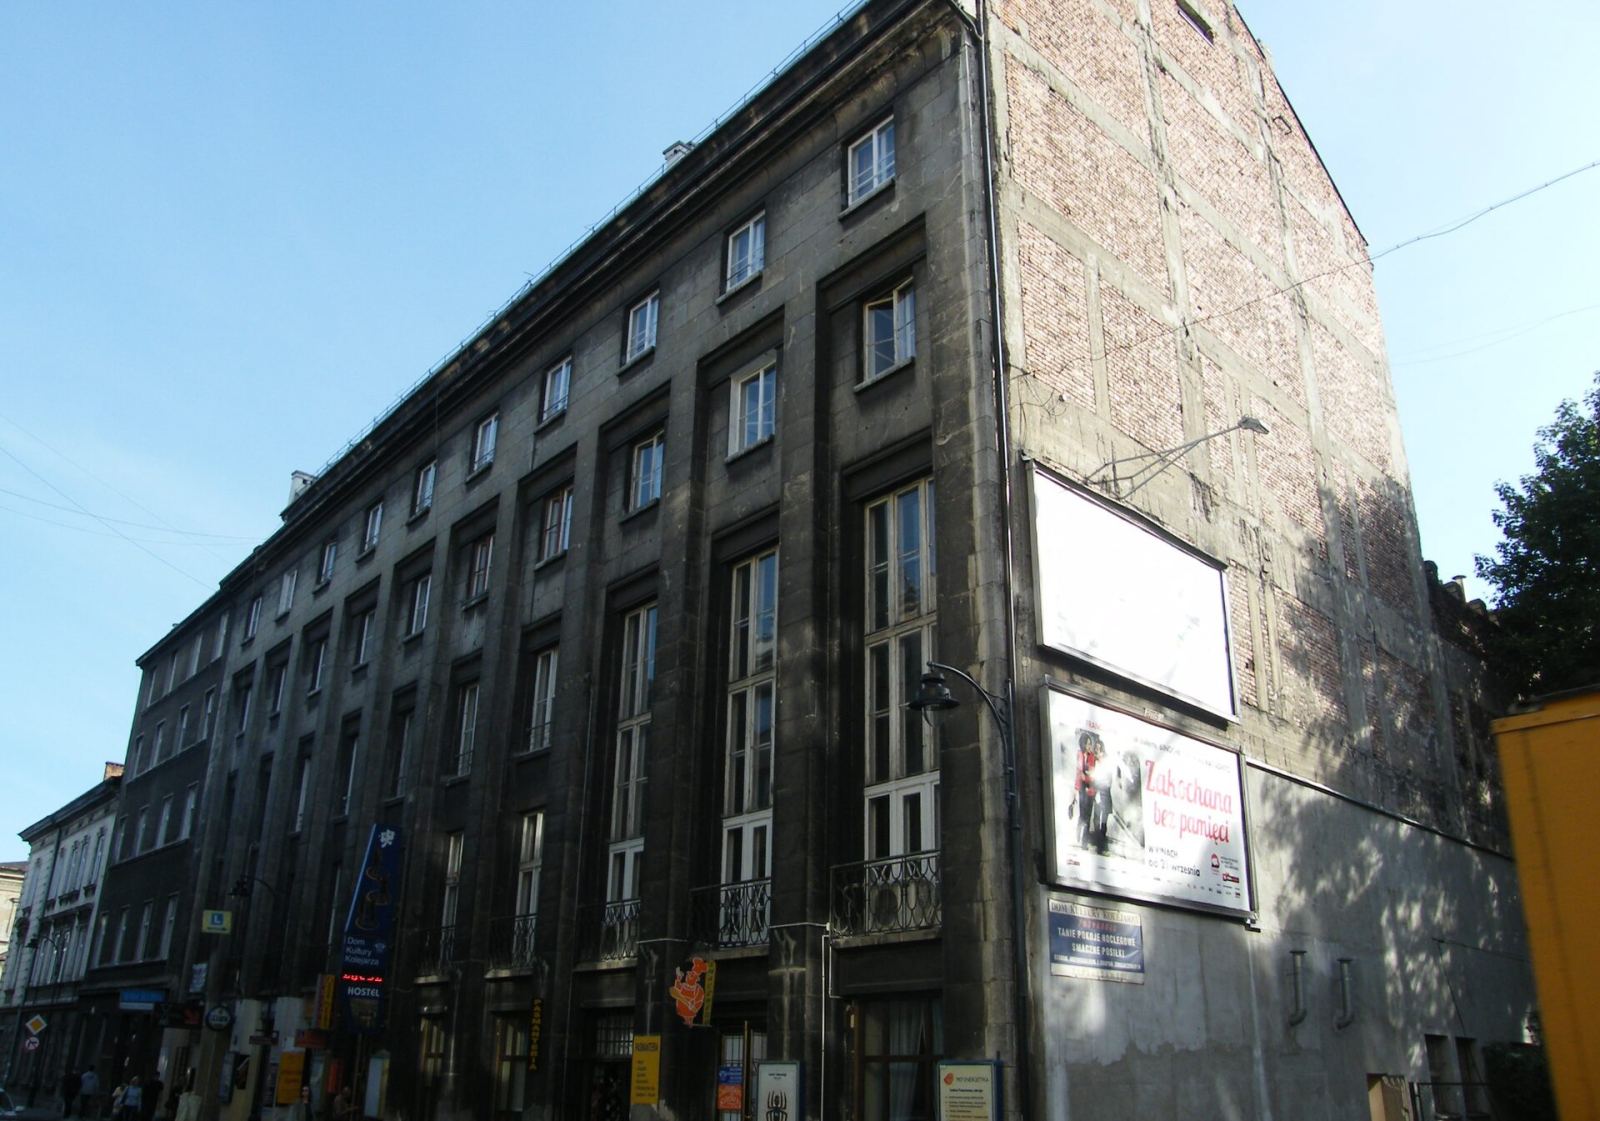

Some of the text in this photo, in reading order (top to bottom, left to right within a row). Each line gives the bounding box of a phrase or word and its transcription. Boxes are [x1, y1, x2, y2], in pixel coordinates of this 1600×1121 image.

[1145, 760, 1232, 814] Zakochana
[1153, 800, 1229, 845] bez pamięci
[213, 914, 220, 923] L
[347, 936, 366, 945] Dom
[1058, 927, 1076, 938] TANIE
[1077, 930, 1100, 942] POKOJE
[347, 986, 380, 997] HOSTEL
